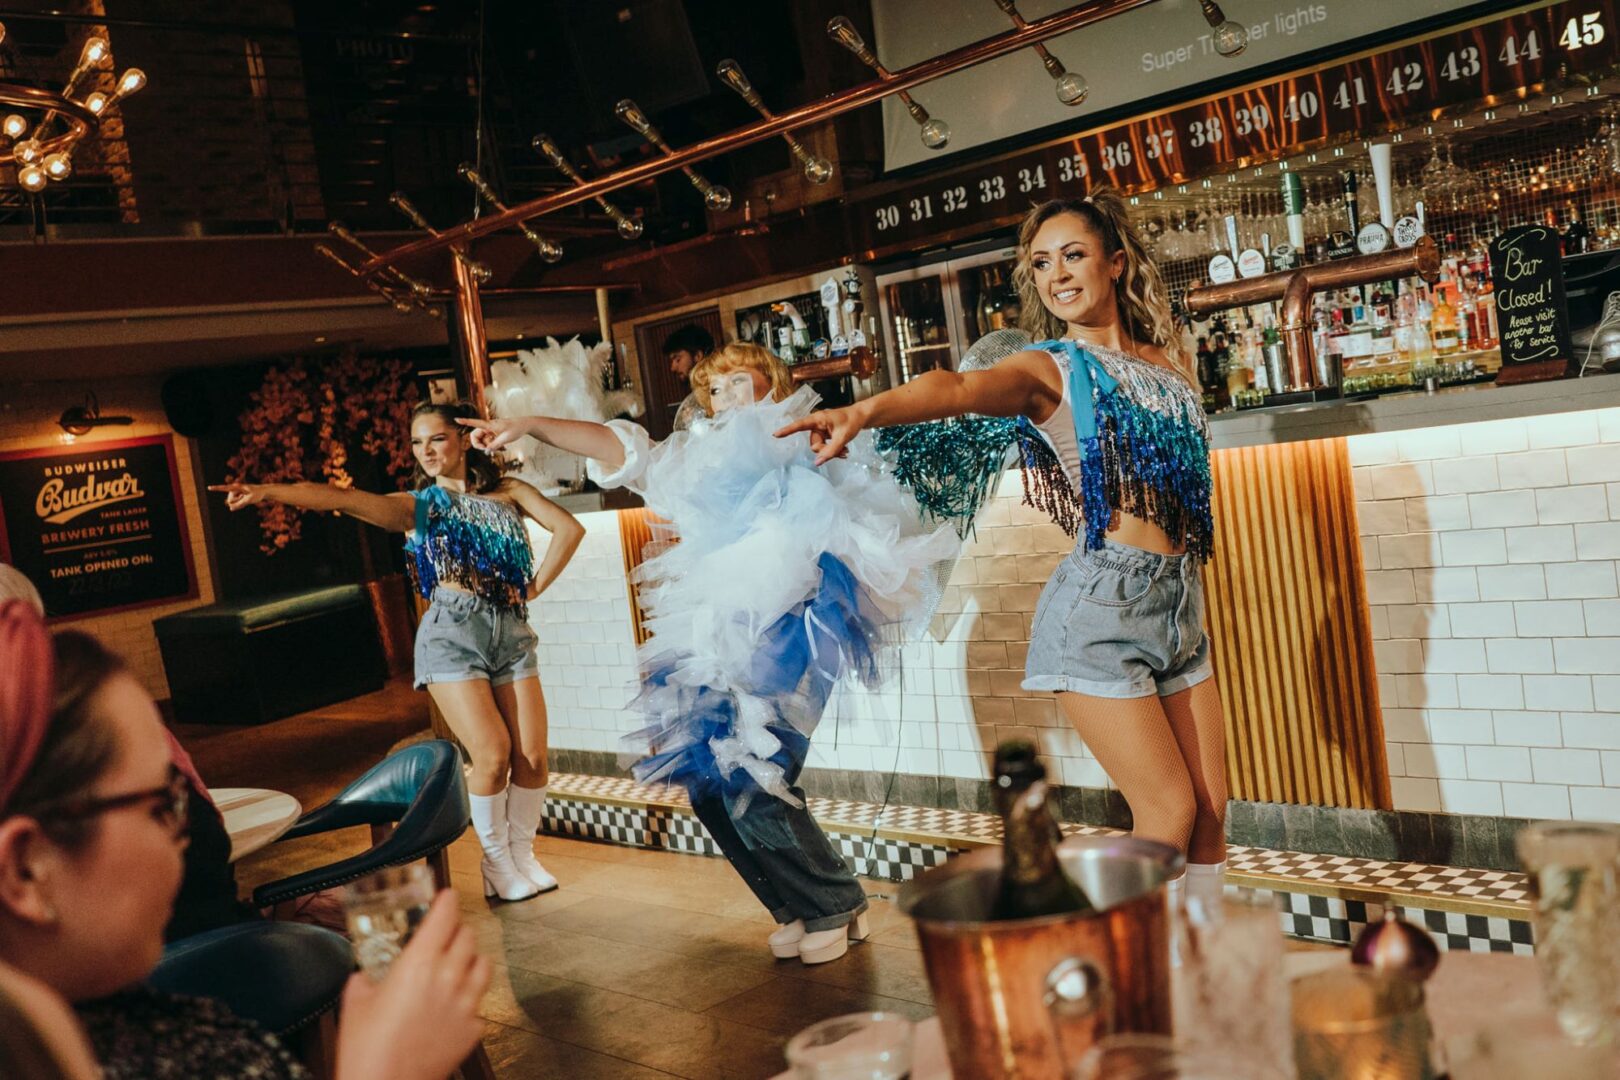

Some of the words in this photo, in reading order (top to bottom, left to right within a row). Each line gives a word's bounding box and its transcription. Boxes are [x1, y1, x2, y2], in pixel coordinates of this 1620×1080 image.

[1142, 43, 1194, 72] Super
[1275, 5, 1327, 36] lights
[876, 206, 899, 231] 30
[910, 196, 933, 222] 31
[942, 186, 967, 214] 32
[979, 176, 1006, 203] 33
[1018, 165, 1047, 193] 34
[1058, 153, 1088, 182] 35
[1101, 142, 1131, 171] 36
[1146, 130, 1174, 159] 37
[1189, 116, 1222, 148] 38
[1236, 104, 1269, 135] 39
[1284, 93, 1318, 122] 40
[1333, 77, 1367, 110] 41
[1385, 62, 1424, 96] 42
[1440, 47, 1481, 81] 43
[1499, 30, 1541, 67] 44
[1559, 11, 1604, 51] 45
[1504, 248, 1543, 281] Bar
[1498, 279, 1552, 311] Closed!
[1535, 308, 1556, 321] visit
[1504, 328, 1534, 340] another
[1538, 321, 1554, 334] bar
[1512, 339, 1524, 349] for
[44, 458, 127, 477] BUDWEISER
[36, 473, 144, 518] Budvar
[100, 510, 121, 519] TANK
[42, 526, 104, 544] BREWERY
[110, 520, 149, 535] FRESH
[51, 565, 82, 578] TANK
[85, 558, 129, 573] OPENED
[132, 554, 153, 565] ON:
